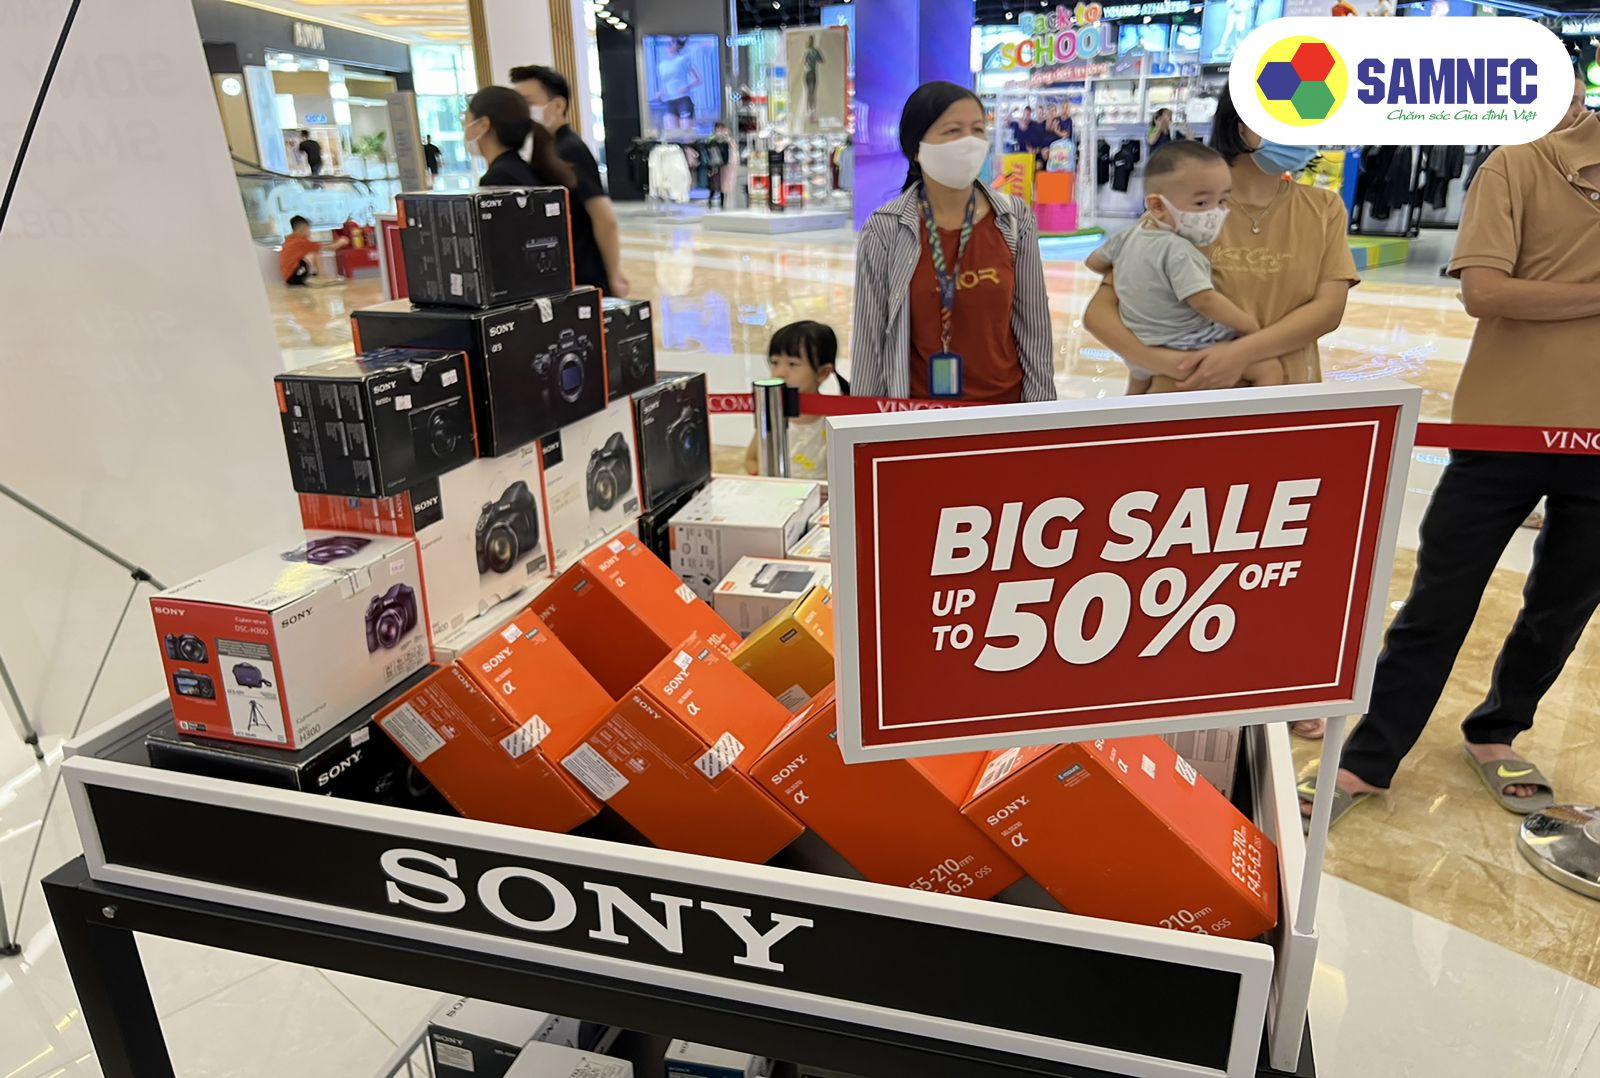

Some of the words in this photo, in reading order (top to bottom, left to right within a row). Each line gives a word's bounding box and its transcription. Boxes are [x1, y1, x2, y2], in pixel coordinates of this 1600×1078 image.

[1074, 2, 1101, 26] to
[1103, 4, 1140, 18] YOUNG
[1000, 22, 1115, 70] SCHOOL
[480, 199, 503, 208] SONY
[489, 321, 516, 337] SONY
[373, 380, 397, 394] SONY
[414, 496, 439, 513] SONY
[930, 496, 1085, 576] BIG
[1100, 478, 1322, 562] SALE
[598, 554, 620, 572] SONY
[1238, 560, 1302, 590] OFF
[155, 607, 186, 616] SONY
[931, 588, 976, 617] UP
[281, 607, 313, 629] SONY
[931, 623, 975, 651] TO
[974, 562, 1240, 672] 50%
[481, 647, 513, 673] SONY
[451, 668, 478, 694] SONY
[663, 668, 690, 696] SONY
[632, 695, 662, 720] SONY
[317, 749, 363, 787] SONY
[771, 754, 808, 785] SONY
[986, 795, 1030, 826] SONY
[974, 865, 992, 879] OSS
[1231, 866, 1246, 884] E
[379, 848, 814, 973] SONY
[1211, 918, 1232, 932] OSS
[433, 1033, 464, 1046] SONY
